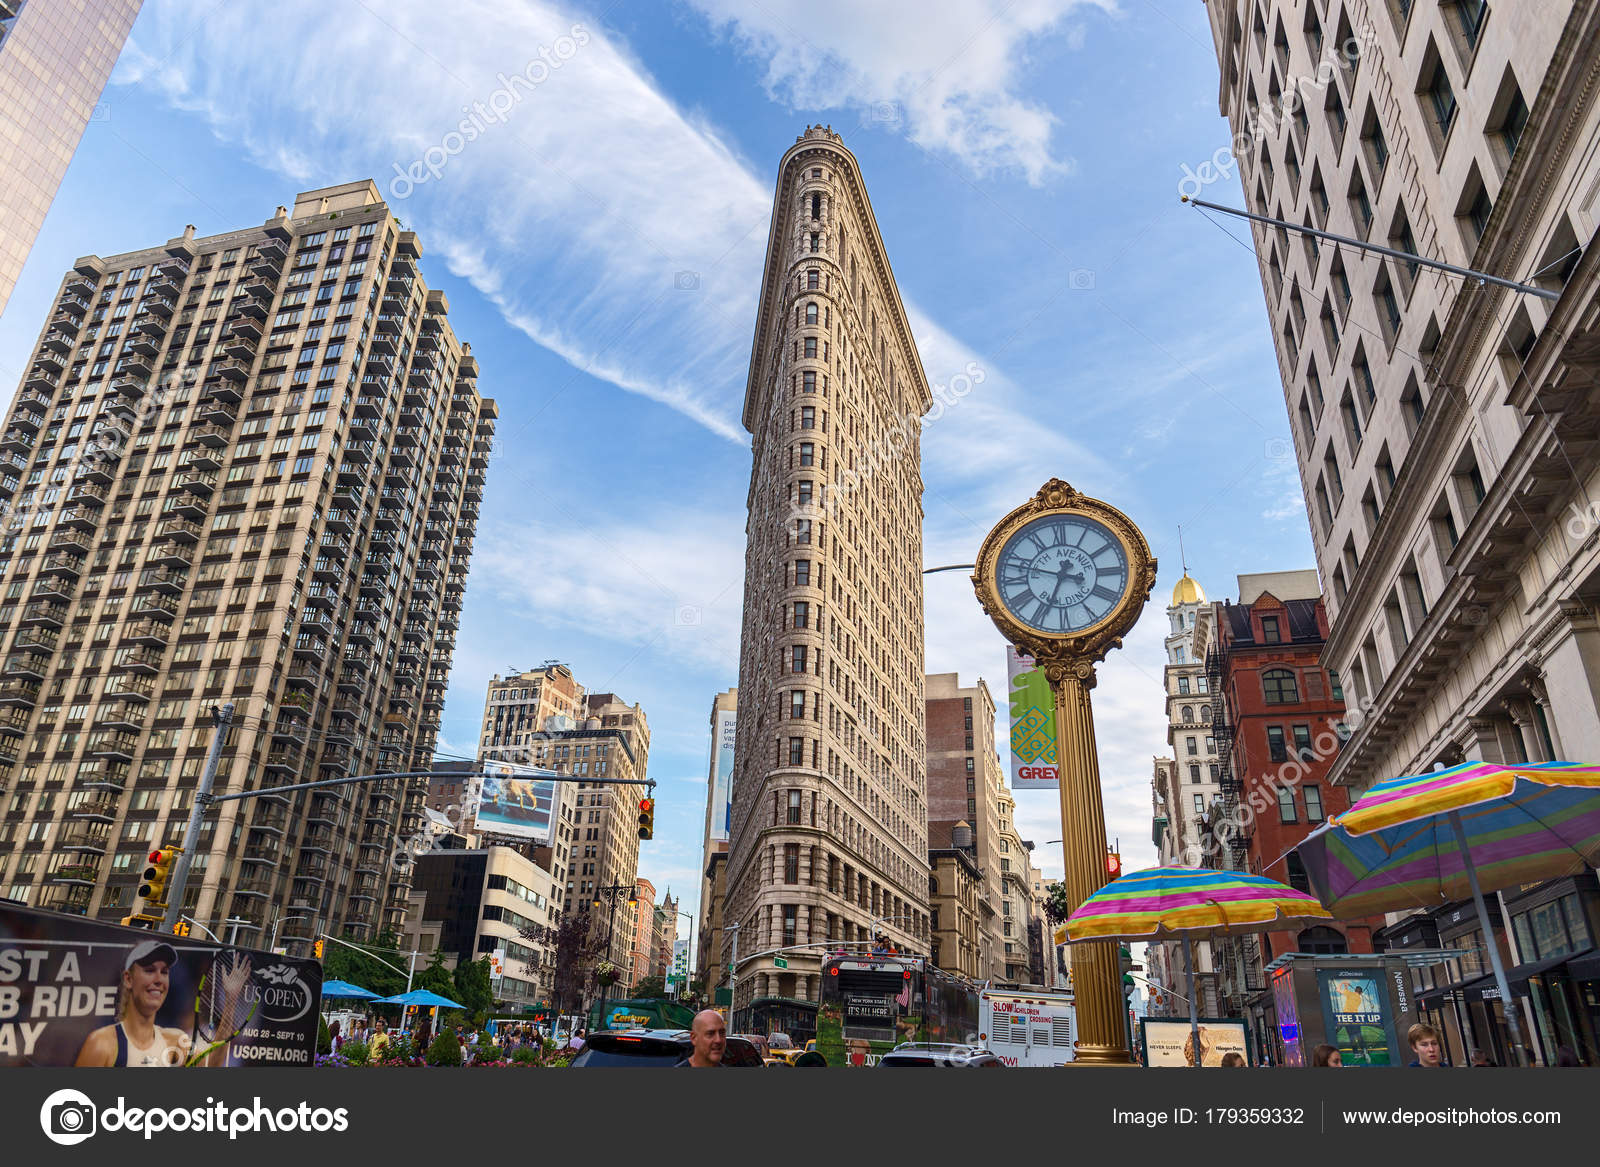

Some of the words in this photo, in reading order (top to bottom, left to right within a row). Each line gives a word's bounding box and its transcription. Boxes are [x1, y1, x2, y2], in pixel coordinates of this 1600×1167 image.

[1056, 549, 1093, 573] AVENUE
[1018, 766, 1059, 780] GREY
[0, 948, 48, 982] ST
[55, 951, 81, 982] A
[0, 985, 21, 1019] B
[30, 986, 118, 1018] RIDE
[244, 984, 262, 1003] US
[264, 988, 304, 1009] OPEN
[613, 1013, 650, 1025] Century
[848, 1006, 860, 1016] IT'S
[860, 1007, 871, 1016] ALL
[872, 1008, 888, 1017] HERE
[1016, 1007, 1039, 1015] CHILDREN
[1336, 1014, 1353, 1022] TEE
[1355, 1014, 1365, 1022] IT
[1367, 1014, 1381, 1022] UP
[0, 1022, 48, 1056] AY
[243, 1028, 259, 1037] AUG
[260, 1029, 270, 1038] 28
[277, 1031, 294, 1040] SEPT
[297, 1033, 304, 1041] 10
[233, 1044, 308, 1062] USOPEN.ORG
